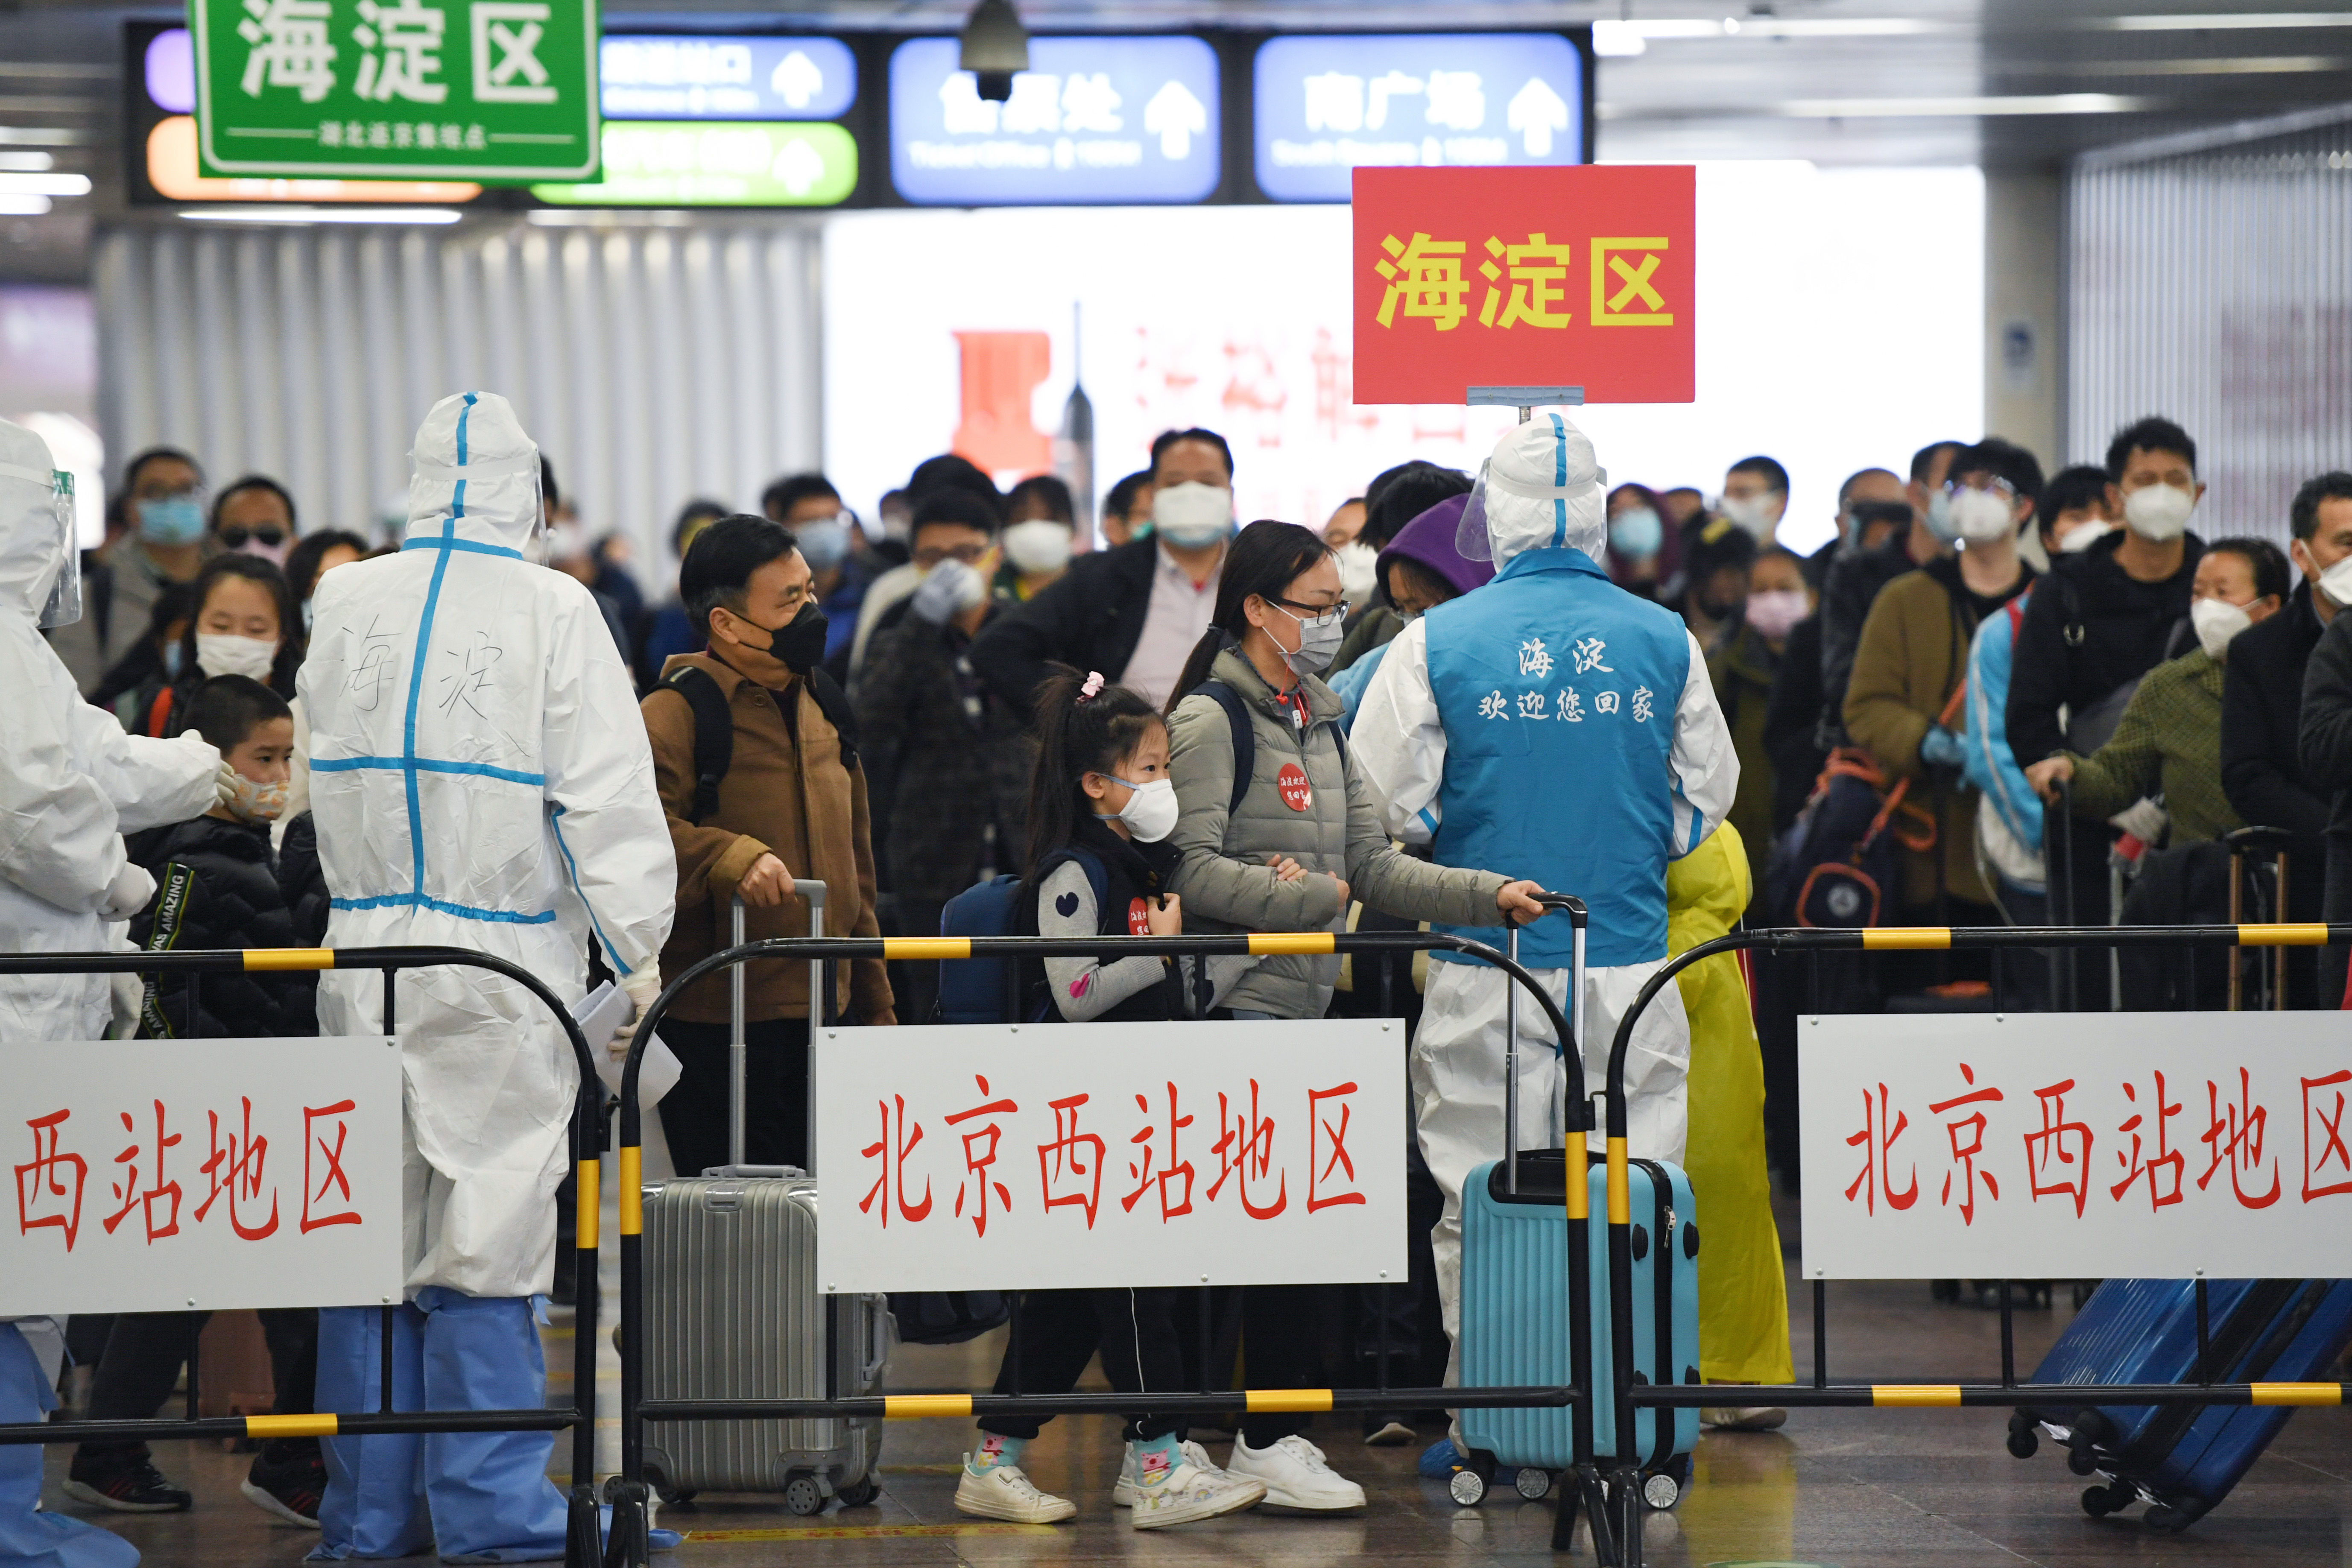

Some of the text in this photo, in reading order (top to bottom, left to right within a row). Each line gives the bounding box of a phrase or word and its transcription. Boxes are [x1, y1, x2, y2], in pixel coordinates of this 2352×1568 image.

[237, 0, 558, 103] 海淀区
[1374, 232, 1674, 331] 海淀区
[339, 613, 531, 758] 海淀
[1477, 685, 1654, 723] 欢迎您回家
[1518, 637, 1614, 679] 海淀
[1280, 775, 1306, 787] 海淀欢迎
[161, 875, 184, 932] AMAZING
[14, 1096, 362, 1253] 西站地区
[859, 1074, 1366, 1238] 北京西站地区
[1845, 1063, 2352, 1226] 北京西站地区
